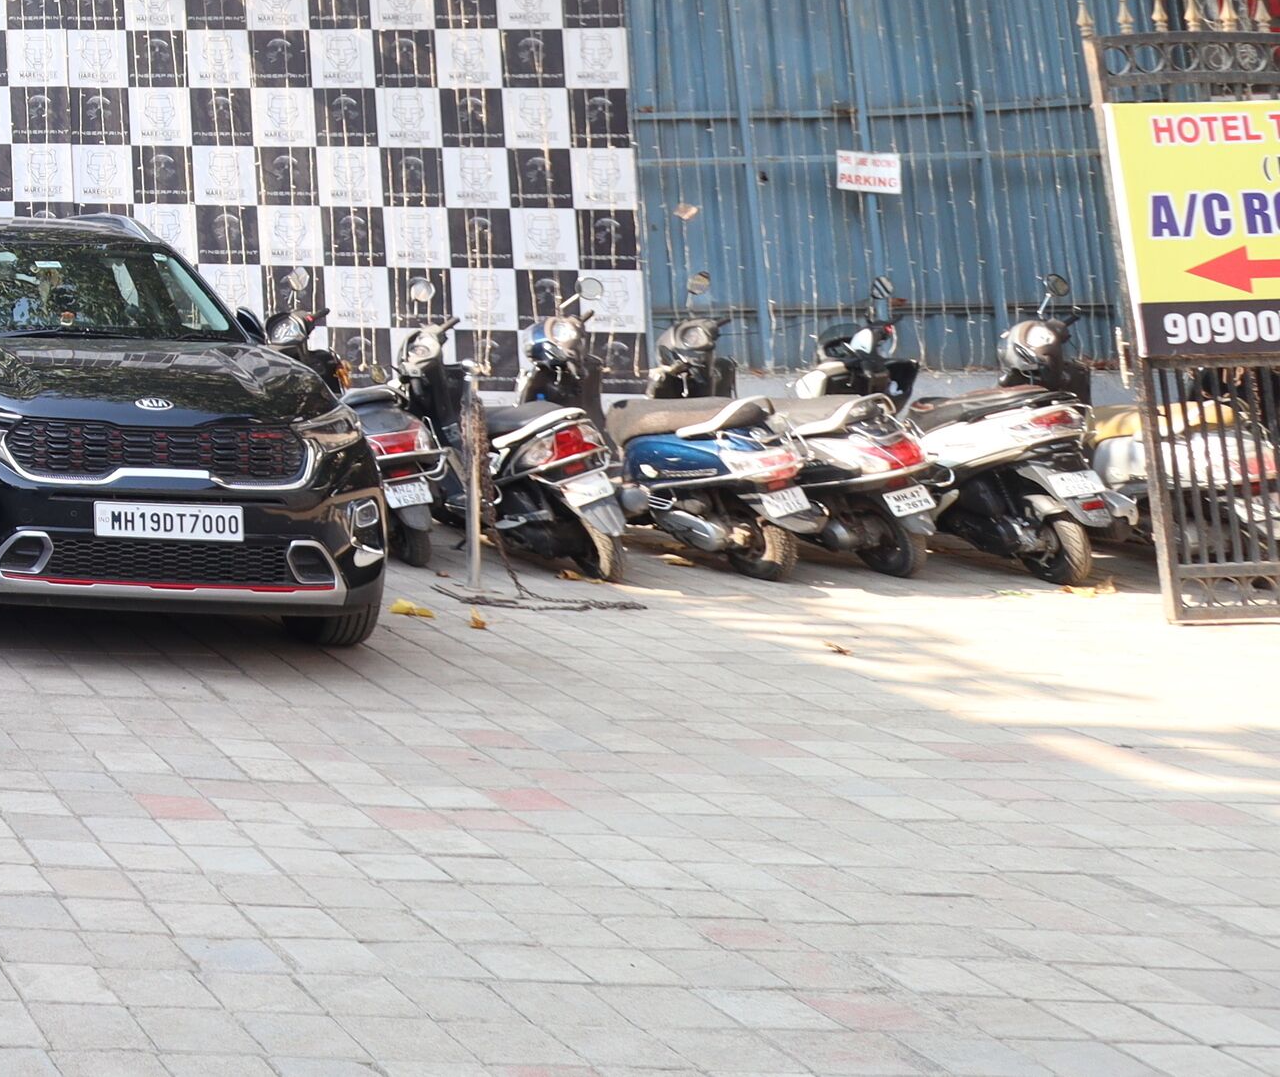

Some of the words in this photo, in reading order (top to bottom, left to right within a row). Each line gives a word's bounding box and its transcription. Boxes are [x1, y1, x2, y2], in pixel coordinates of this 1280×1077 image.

[1152, 115, 1262, 143] HOTEL
[840, 173, 897, 188] PARKING
[1151, 192, 1232, 237] A/C
[111, 510, 239, 534] MH19DT7000
